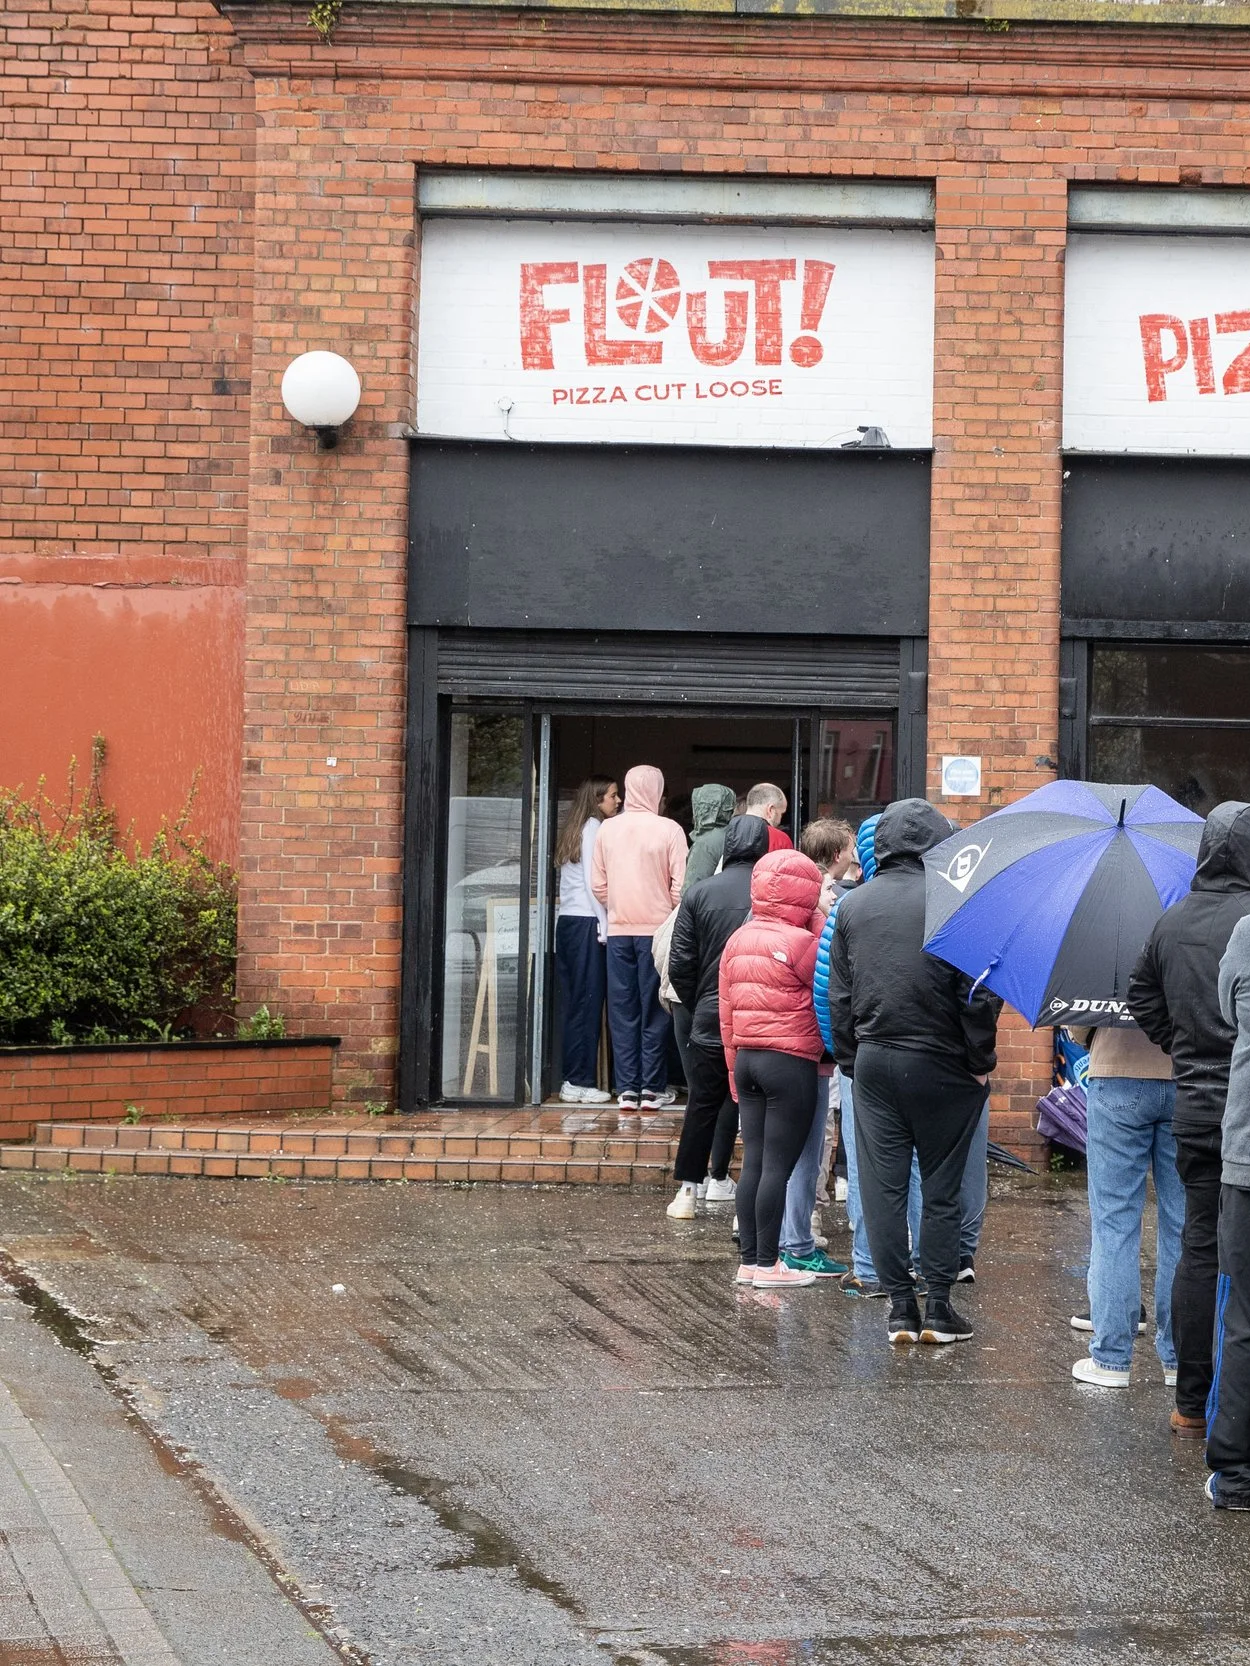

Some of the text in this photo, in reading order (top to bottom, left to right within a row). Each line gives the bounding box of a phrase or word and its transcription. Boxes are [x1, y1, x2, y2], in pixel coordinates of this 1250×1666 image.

[519, 257, 836, 371] FLOUT!
[552, 379, 783, 405] PIZZA CUT LOOSE
